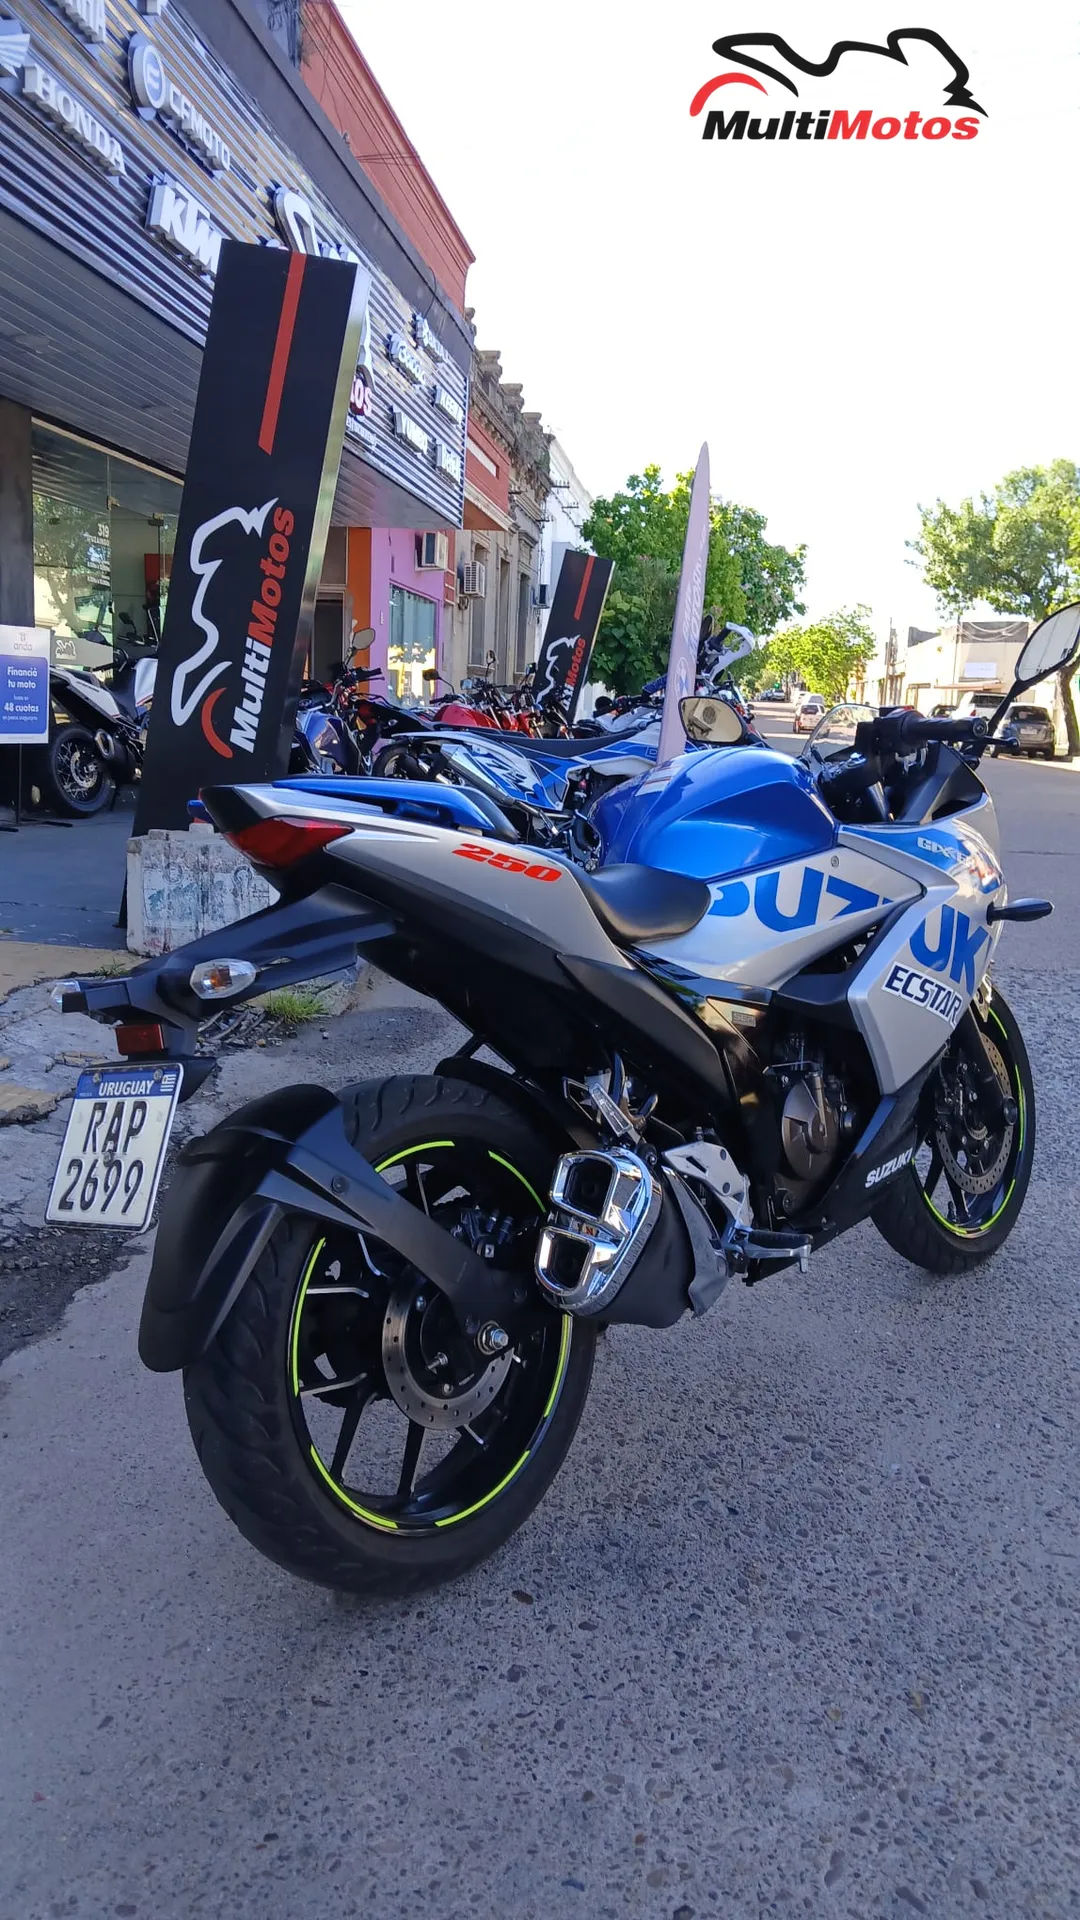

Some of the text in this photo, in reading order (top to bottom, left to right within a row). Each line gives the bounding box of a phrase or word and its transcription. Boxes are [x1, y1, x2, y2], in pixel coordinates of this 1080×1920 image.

[24, 63, 127, 177] HONDA
[168, 78, 231, 172] CFMOTO
[150, 180, 223, 276] KTM
[230, 506, 295, 754] MultiMotos
[4, 702, 39, 713] 48 cuotas
[17, 680, 36, 689] moto
[452, 843, 562, 882] 250
[884, 963, 963, 1025] ECSTAR
[98, 1079, 154, 1096] URUGUAY
[82, 1100, 148, 1155] RAP
[58, 1157, 145, 1215] 2699
[864, 1147, 913, 1188] SUZUKI
